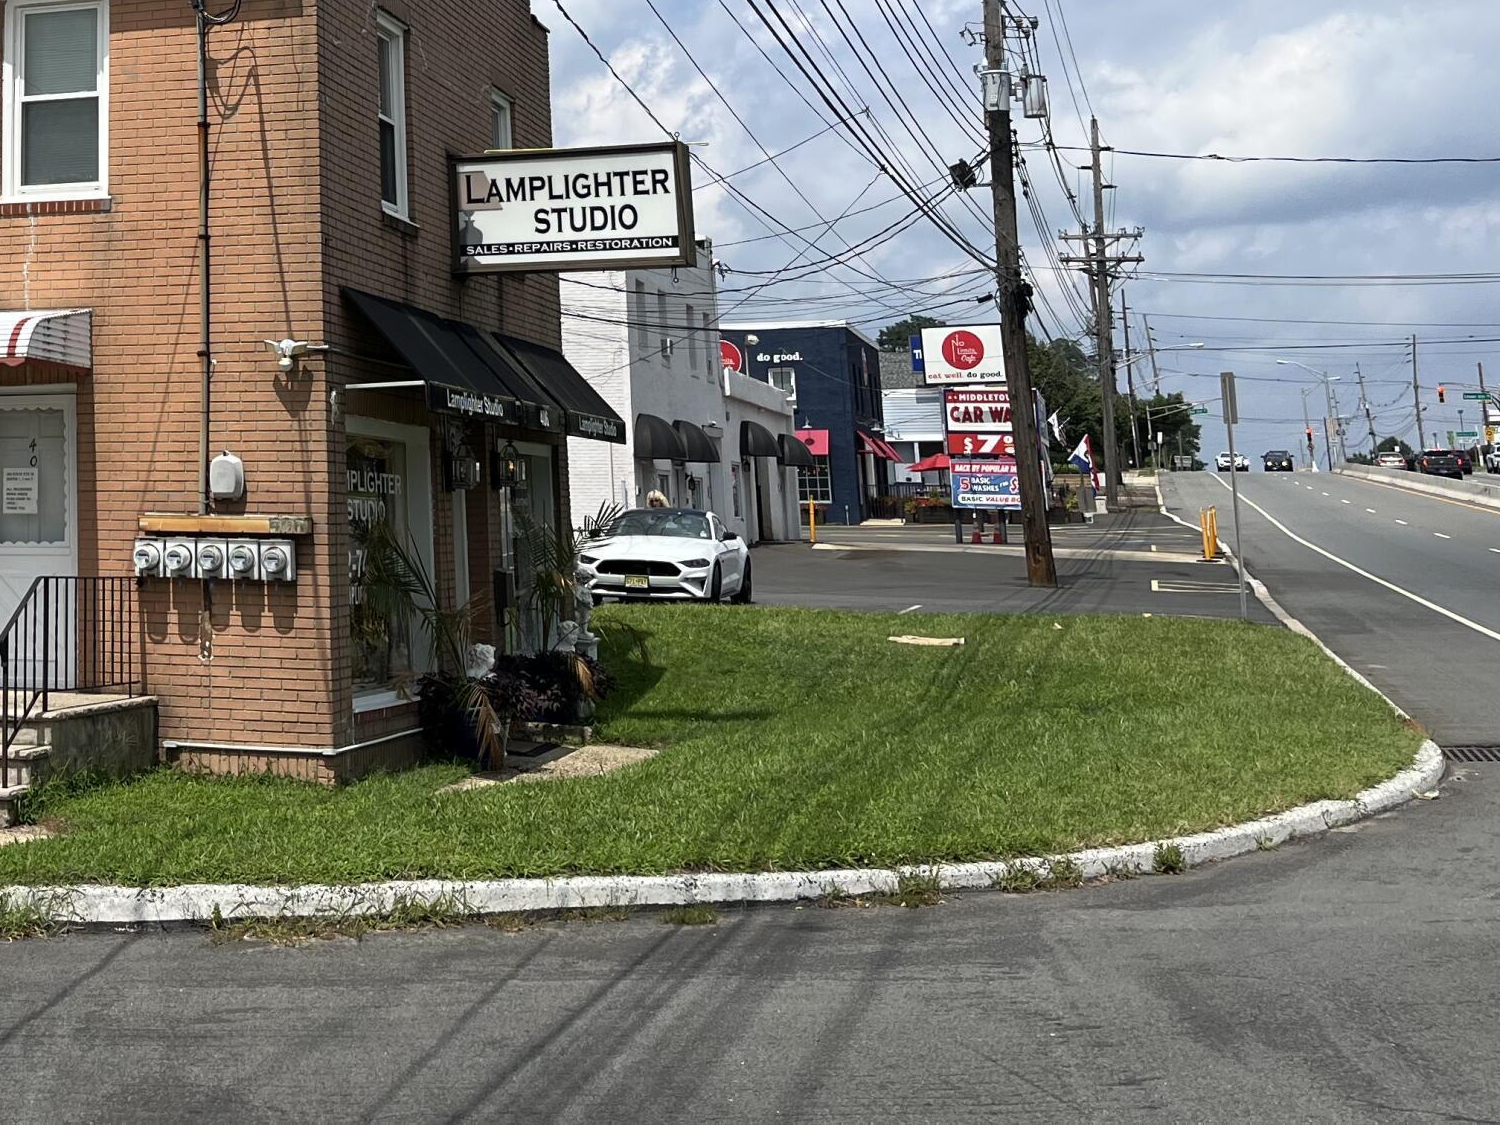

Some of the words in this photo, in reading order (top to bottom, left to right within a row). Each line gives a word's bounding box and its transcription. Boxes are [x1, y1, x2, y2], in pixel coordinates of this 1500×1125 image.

[465, 168, 671, 205] LAMPLIGHTER
[534, 203, 639, 234] STUDIO
[466, 245, 508, 255] SALES
[514, 241, 571, 253] REPAIRS
[578, 237, 673, 251] RESTORATION
[951, 334, 965, 363] No
[757, 353, 770, 362] do
[773, 352, 804, 363] good.
[446, 388, 484, 416] Lamplighter
[483, 394, 504, 417] Studio
[950, 406, 985, 423] CAR
[981, 464, 1009, 473] POPULAR
[960, 477, 971, 492] 5
[971, 476, 991, 484] BASIC
[972, 484, 999, 492] WASHES
